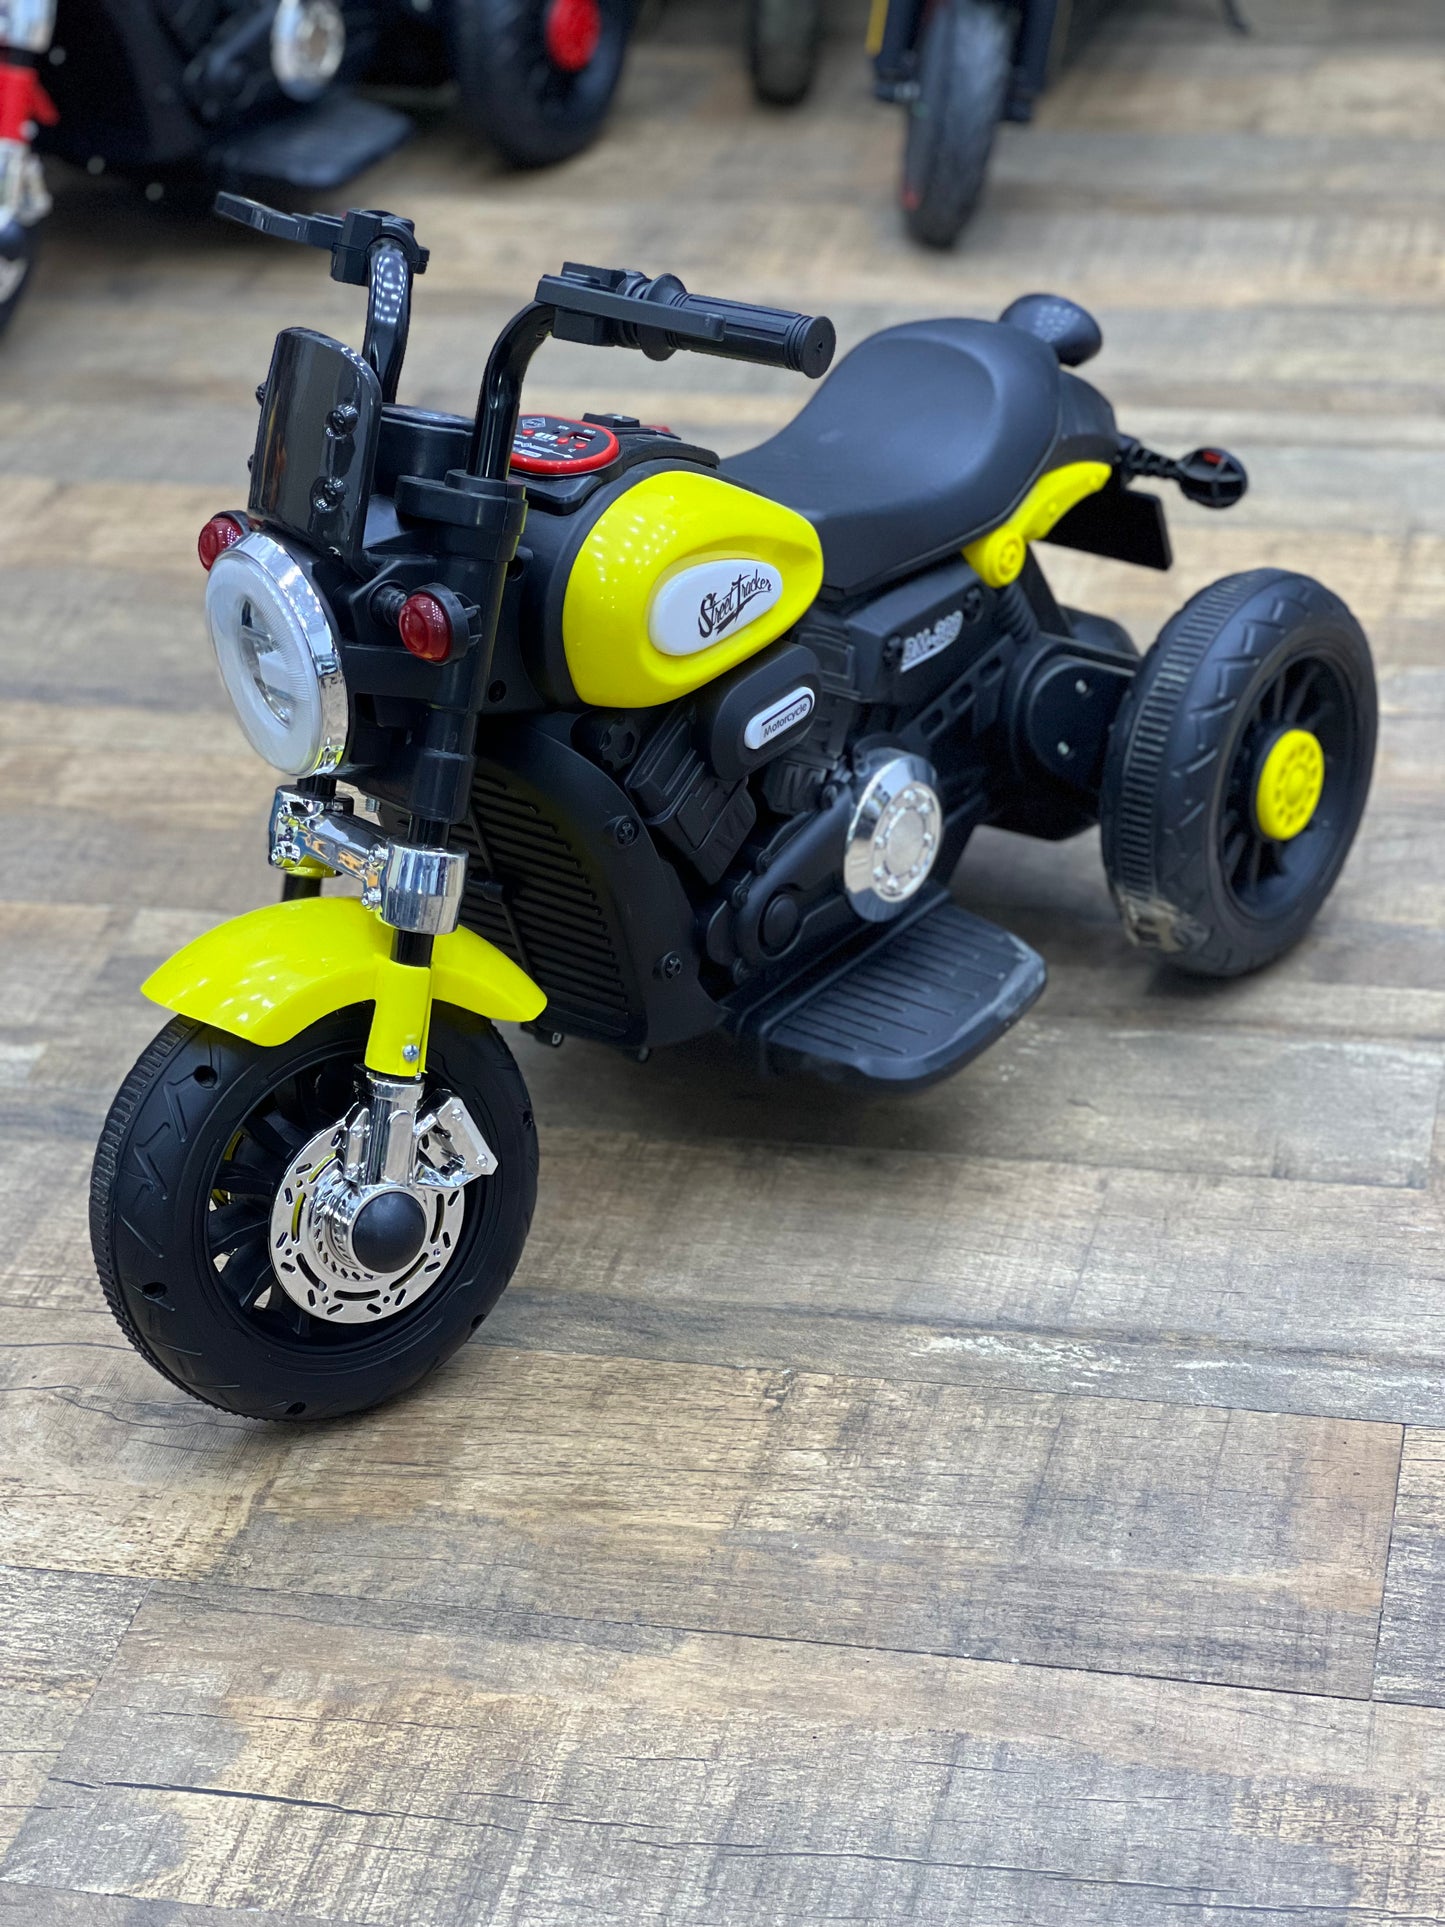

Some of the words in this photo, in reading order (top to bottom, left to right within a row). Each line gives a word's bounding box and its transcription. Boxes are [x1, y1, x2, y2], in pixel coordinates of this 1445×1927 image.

[698, 587, 736, 638] Street
[731, 568, 772, 622] Tracker
[763, 702, 808, 738] Motorcycle
